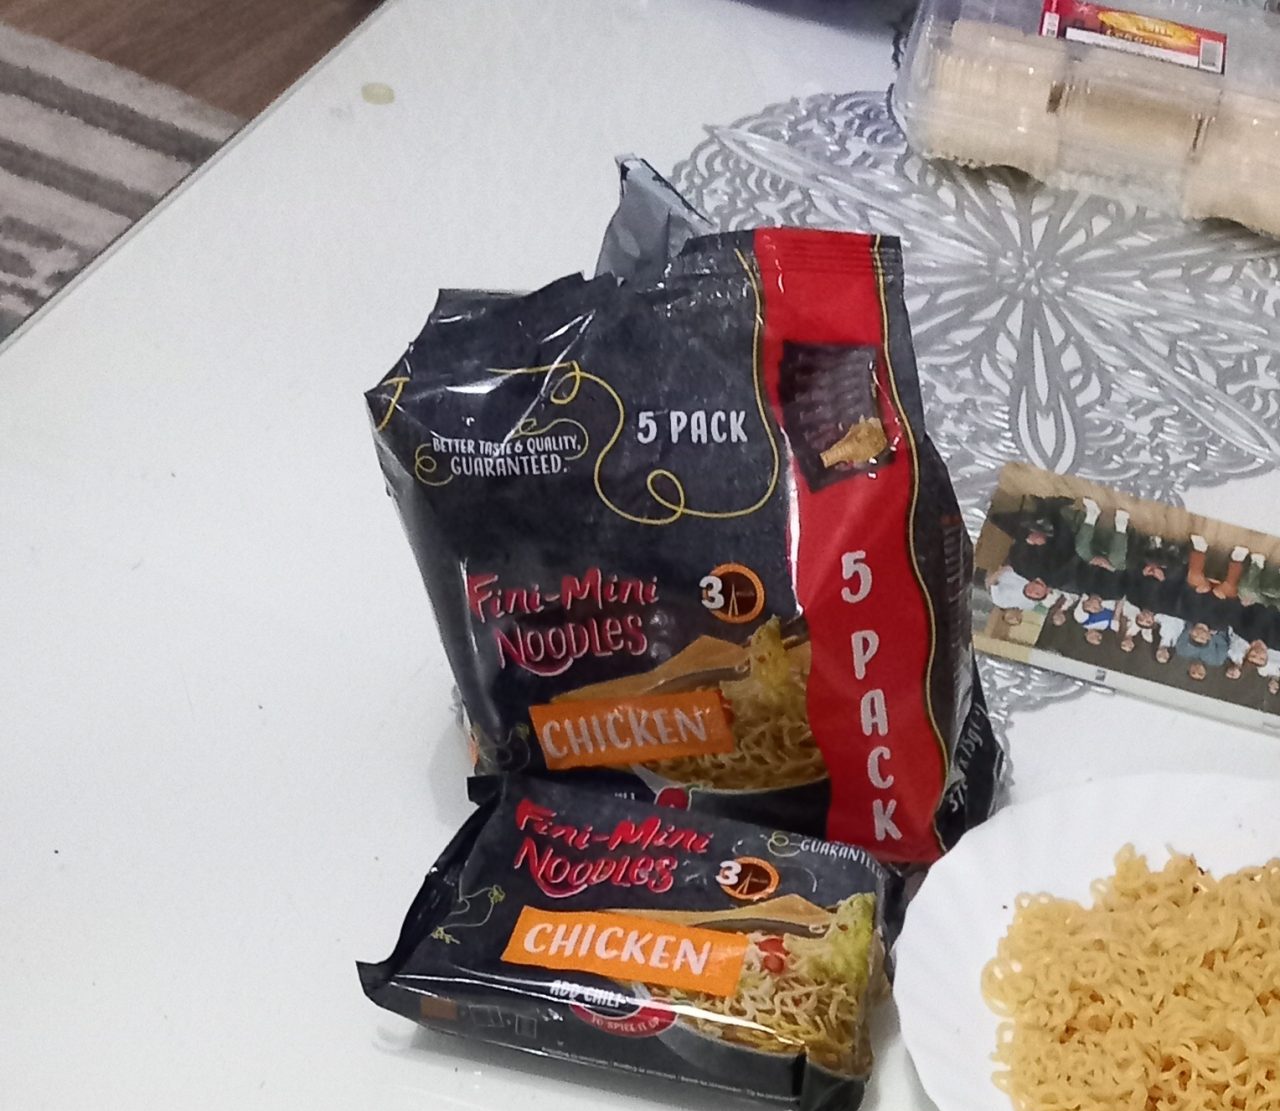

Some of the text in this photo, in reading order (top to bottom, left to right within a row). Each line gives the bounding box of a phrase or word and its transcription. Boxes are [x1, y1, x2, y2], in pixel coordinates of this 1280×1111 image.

[432, 437, 476, 454] BETTER
[479, 440, 512, 457] TASTE
[526, 434, 581, 453] QUALITY,
[637, 410, 748, 444] 5 PACK
[450, 453, 568, 477] GUARANTEED.
[467, 567, 660, 624] Fini-Mini
[699, 575, 725, 609] 3
[840, 549, 873, 604] 5
[542, 704, 709, 759] CHICKEN
[515, 799, 713, 854] Fini-Mini
[715, 860, 742, 886] 3
[523, 923, 714, 977] CHICKEN
